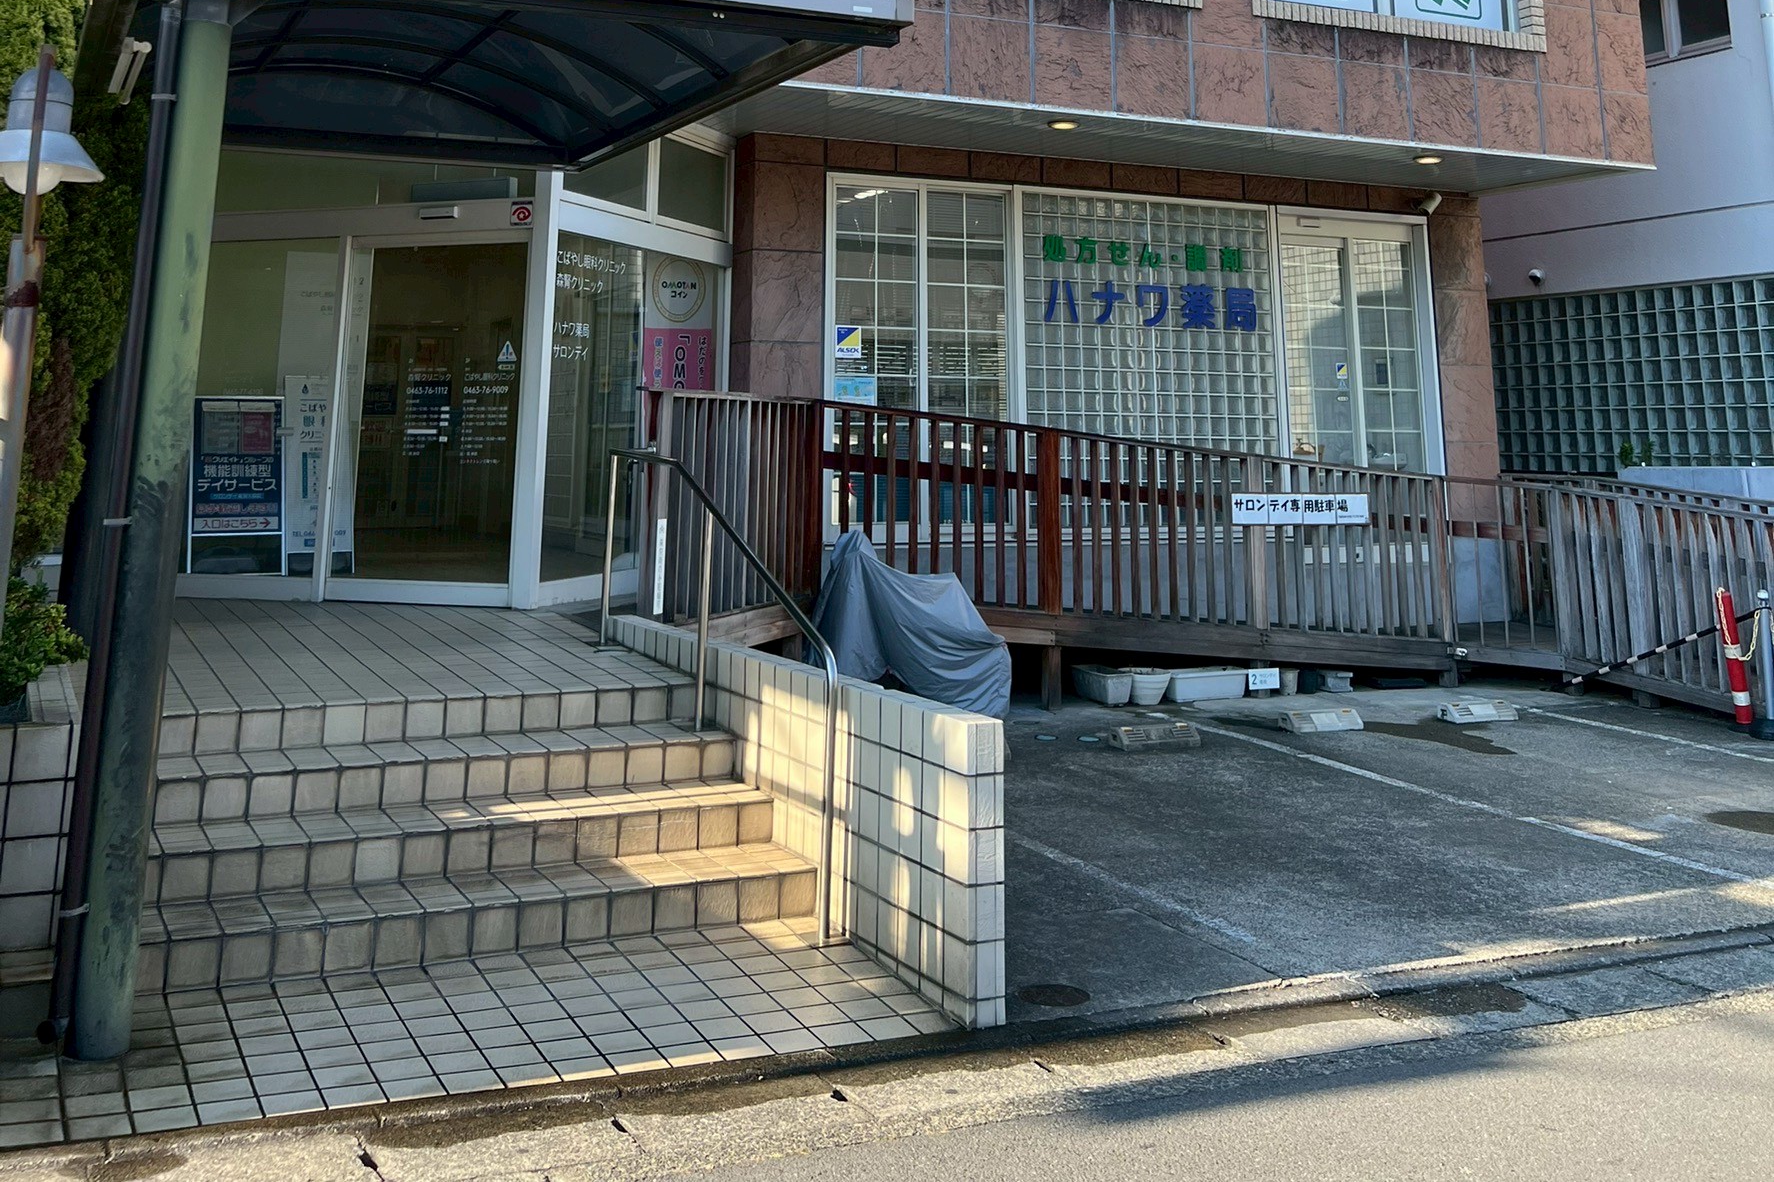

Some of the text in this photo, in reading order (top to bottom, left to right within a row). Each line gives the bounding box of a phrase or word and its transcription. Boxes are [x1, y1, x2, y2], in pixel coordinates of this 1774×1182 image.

[1043, 234, 1243, 273] 処方せん・調剤
[556, 250, 626, 275] こばやし眼科クリニック
[556, 272, 604, 294] 森腎クリニック
[661, 281, 697, 290] OMOTAN
[1044, 280, 1257, 332] ハナワ薬局
[553, 321, 590, 339] ハナワ薬局
[463, 386, 509, 394] 0463-76-9009
[203, 464, 272, 478] 機能訓練型
[197, 479, 277, 492] デイサービス
[1234, 498, 1349, 513] サロンデイ専用駐車場
[201, 519, 258, 529] 入口はこちら
[1251, 673, 1257, 685] 2
